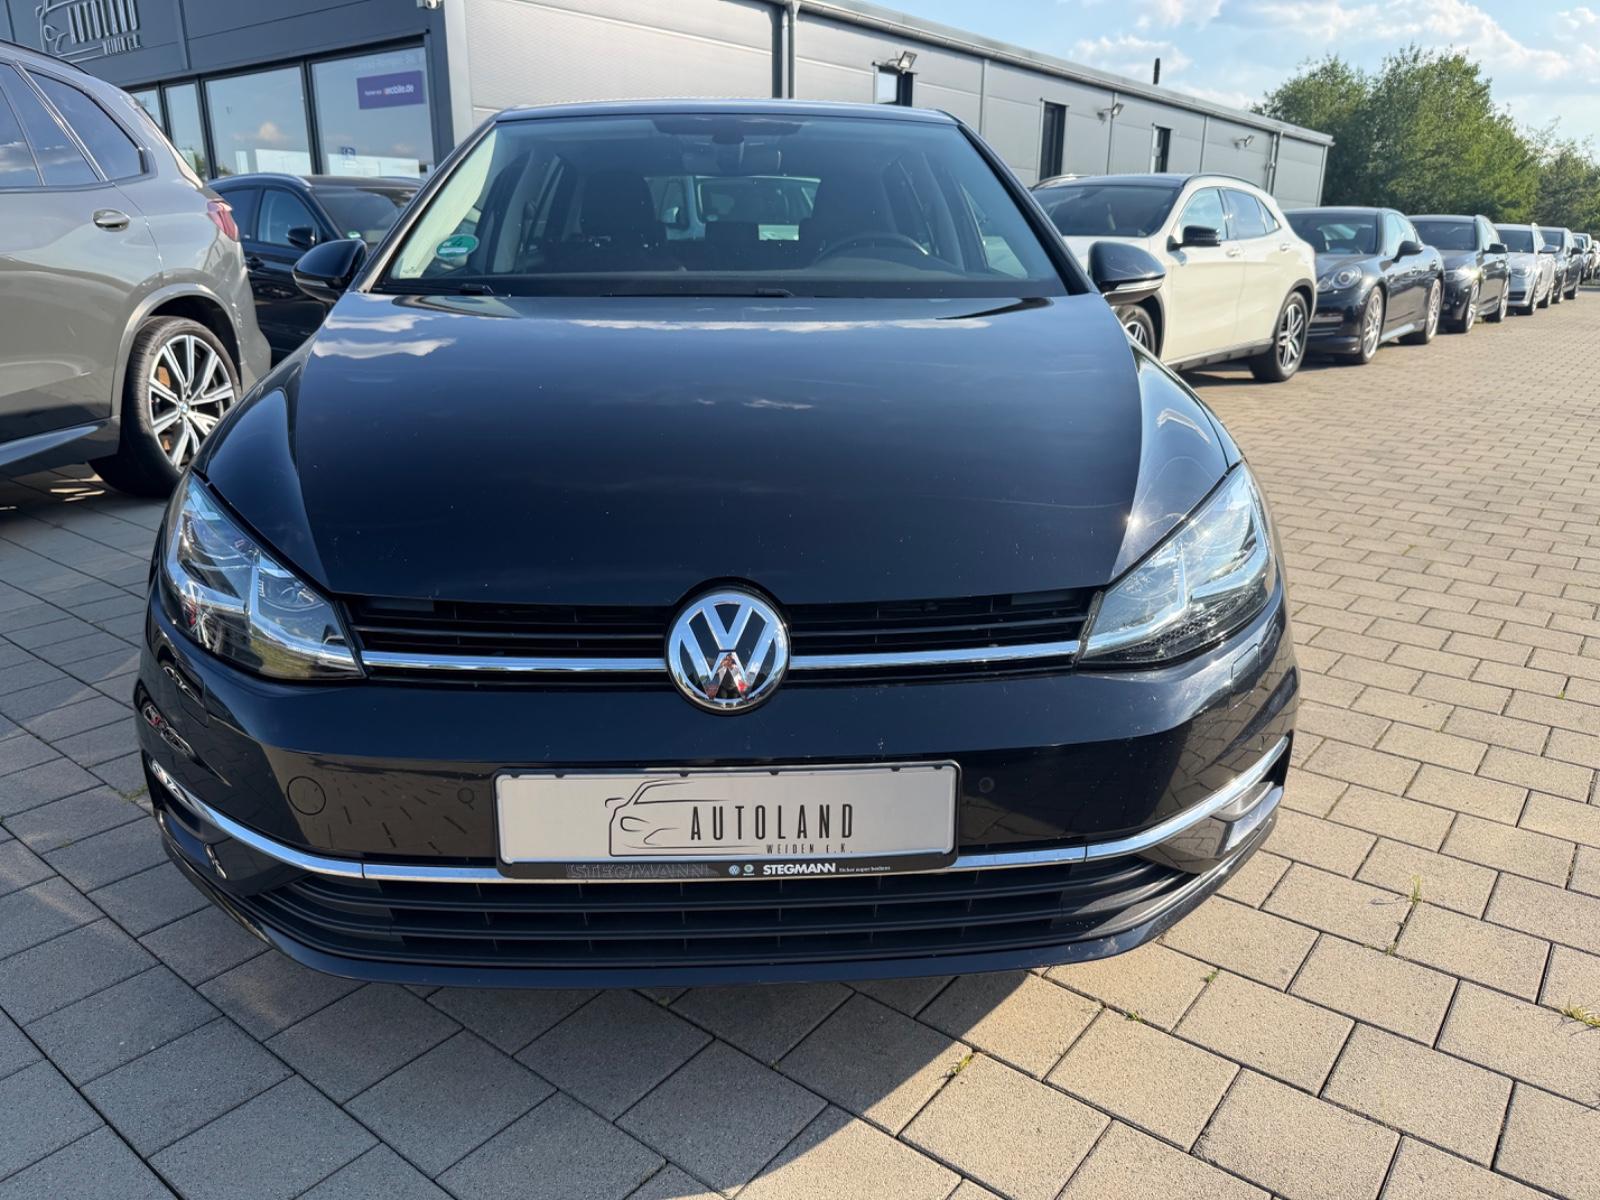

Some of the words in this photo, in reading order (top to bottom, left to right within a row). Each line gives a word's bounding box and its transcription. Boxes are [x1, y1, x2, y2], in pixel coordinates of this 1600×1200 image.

[67, 0, 138, 44] AUTOLAND
[690, 803, 853, 841] AUTOLAND
[766, 844, 814, 855] WEIDEN
[763, 862, 836, 876] STEGMANN
